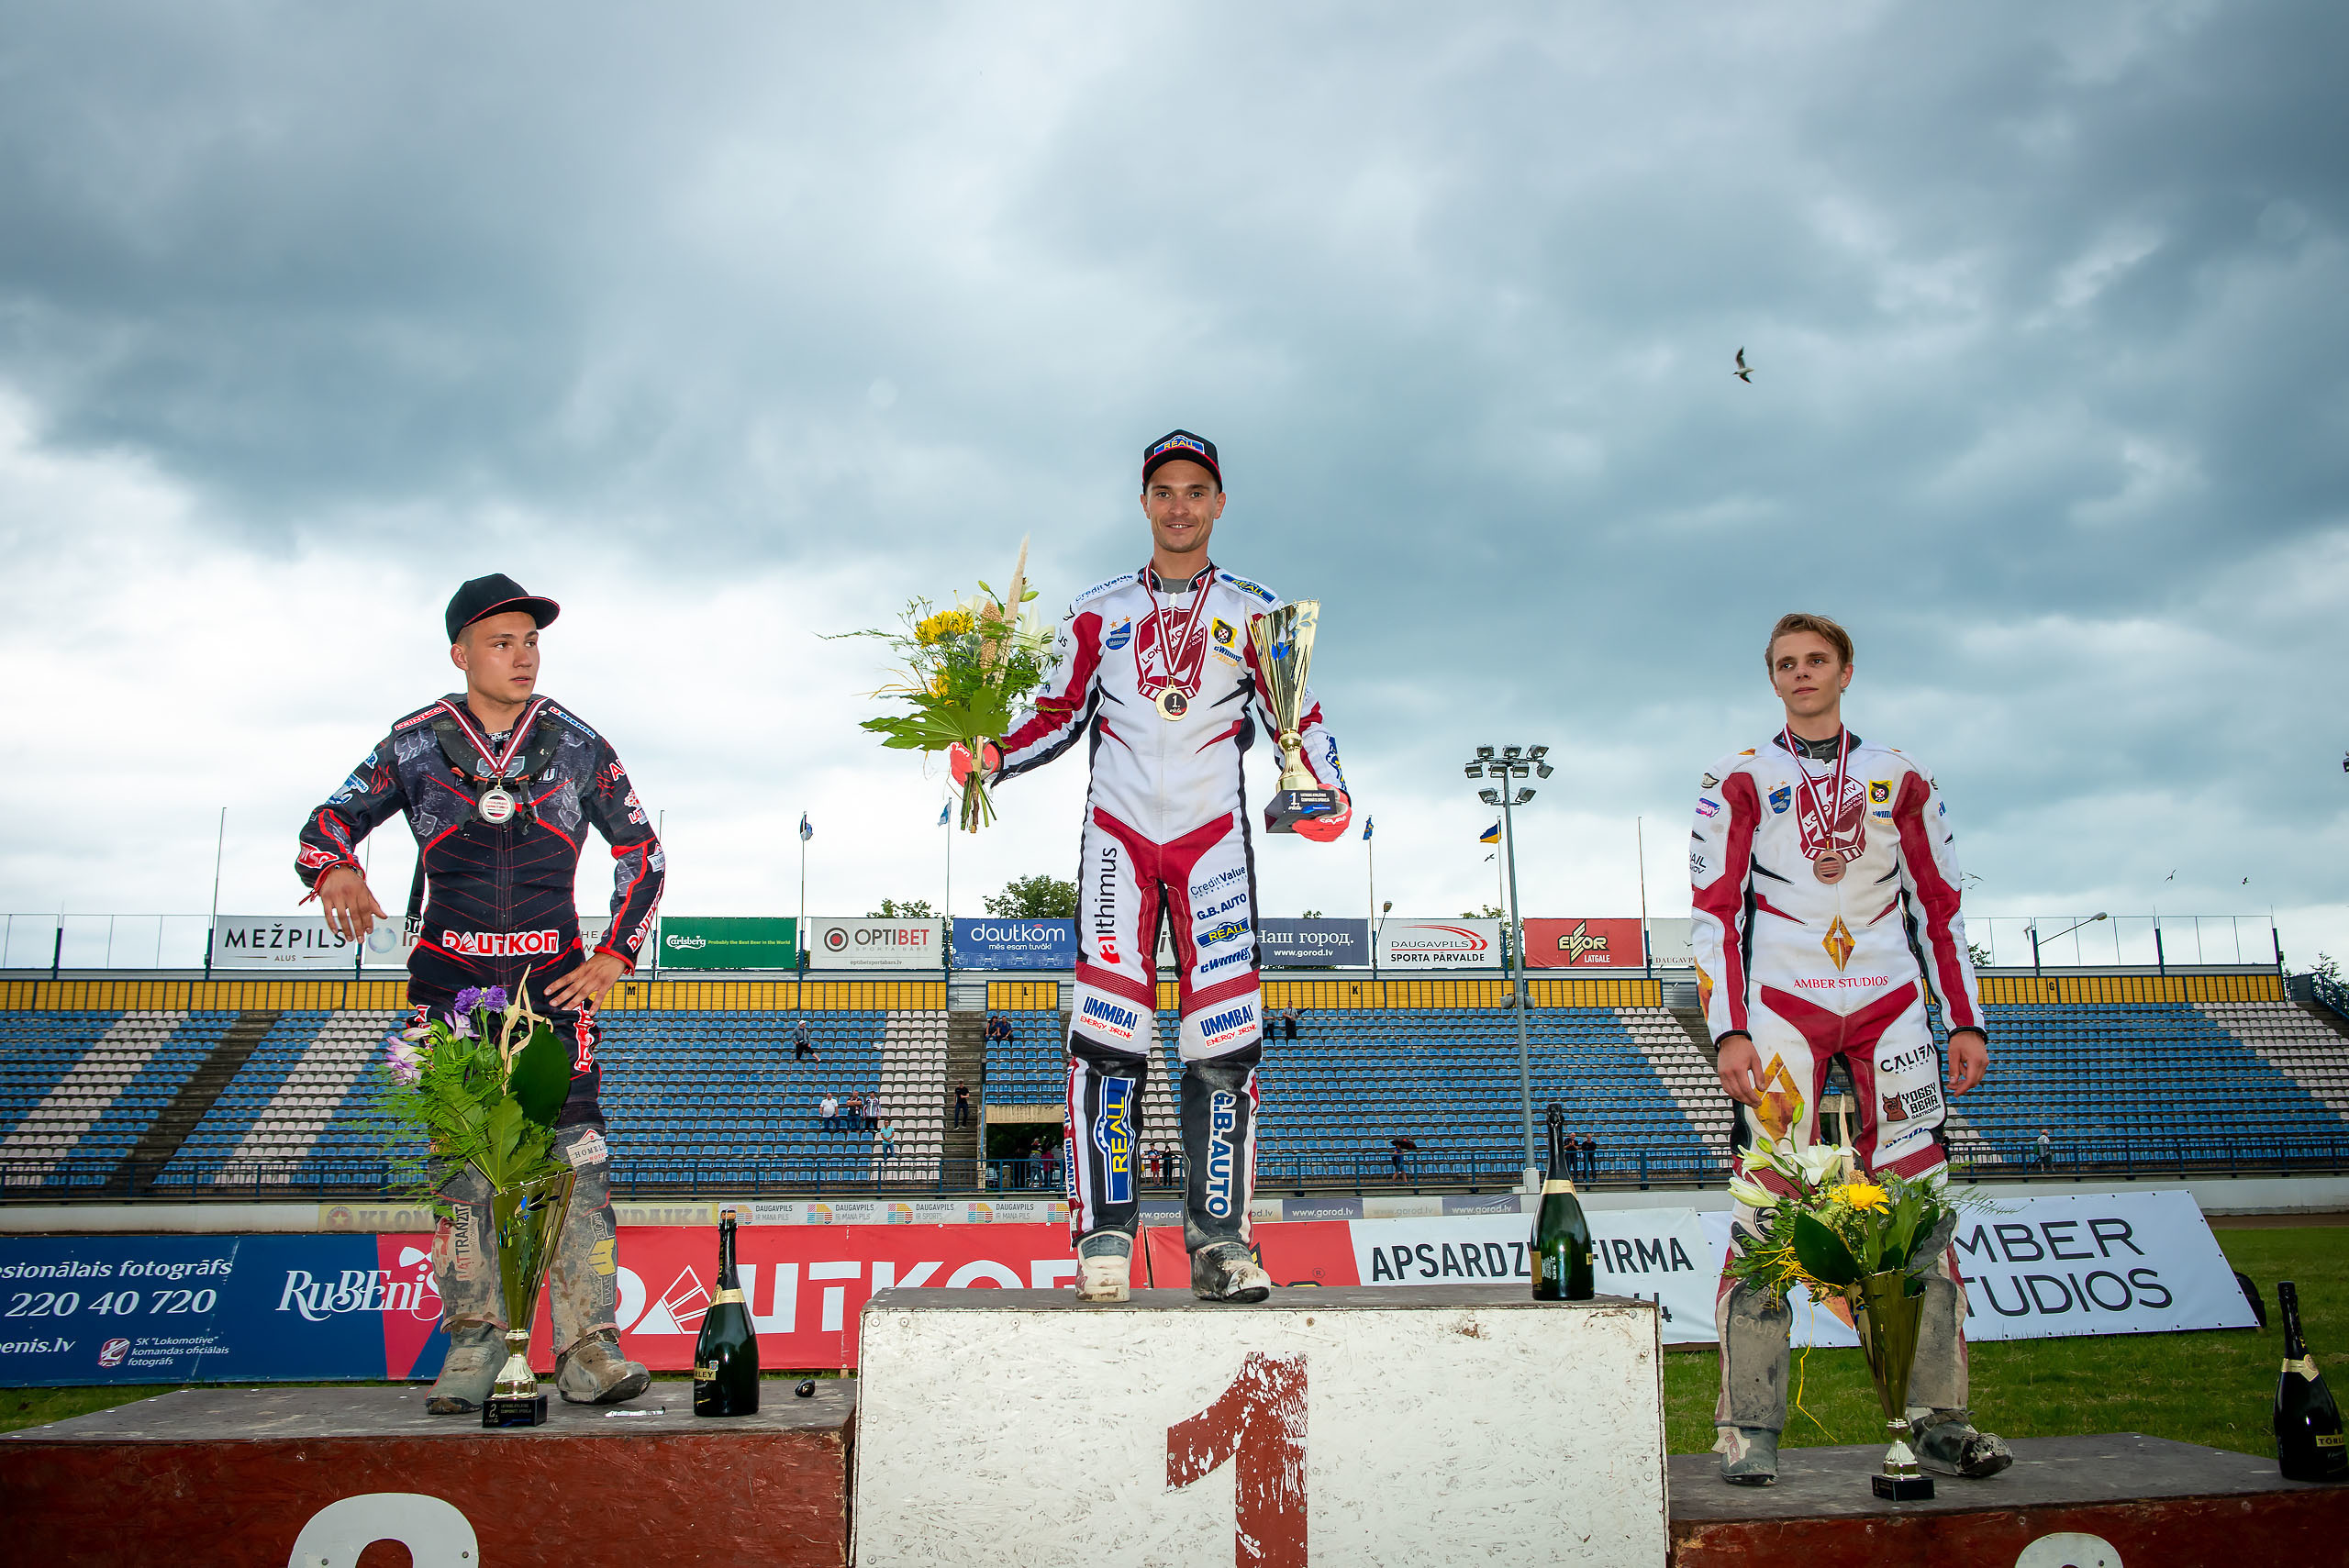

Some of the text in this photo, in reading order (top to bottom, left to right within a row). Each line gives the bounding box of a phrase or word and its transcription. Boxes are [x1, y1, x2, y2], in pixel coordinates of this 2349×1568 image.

[1163, 440, 1196, 450] REALL
[1231, 577, 1264, 598] REALL
[1220, 893, 1247, 911] AUTO
[224, 923, 347, 949] MEŽPILS
[854, 928, 930, 946] OPTIBET
[1208, 923, 1246, 942] REALL
[1298, 930, 1354, 949] город.
[666, 934, 707, 950] Carlsberg
[1274, 948, 1334, 959] www.gorod.lv
[1391, 951, 1485, 962] SPORTA PĀRVALDE
[1584, 954, 1610, 963] LATGALE
[1352, 985, 1359, 995] K
[1793, 975, 1889, 990] AMBER STUDIOS
[2048, 982, 2055, 992] G
[627, 986, 636, 996] M
[1023, 986, 1029, 996] L
[1083, 995, 1138, 1030] UMMBA!
[1199, 1004, 1254, 1037] UMMBA!
[1079, 1015, 1132, 1040] ENERGY DRINK
[1206, 1031, 1236, 1048] ENERGY
[1901, 1082, 1937, 1105] YOGGY
[1909, 1095, 1939, 1115] BEAR
[1107, 1096, 1128, 1173] REALL
[835, 1204, 874, 1212] DAUGAVPILS
[916, 1203, 954, 1211] DAUGAVPILS
[996, 1203, 1034, 1211] DAUGAVPILS
[1292, 1208, 1354, 1218] www.gorod.lv
[1452, 1204, 1513, 1215] www.gorod.lv
[0, 1259, 233, 1280] sionālais fotogrāfs
[5, 1288, 217, 1317] 220 40 720
[0, 1337, 76, 1353] enis.lv
[135, 1338, 150, 1346] SK
[131, 1345, 229, 1357] komandas oficiālais
[128, 1357, 173, 1368] fotogrāfs
[1167, 1351, 1308, 1568] 1
